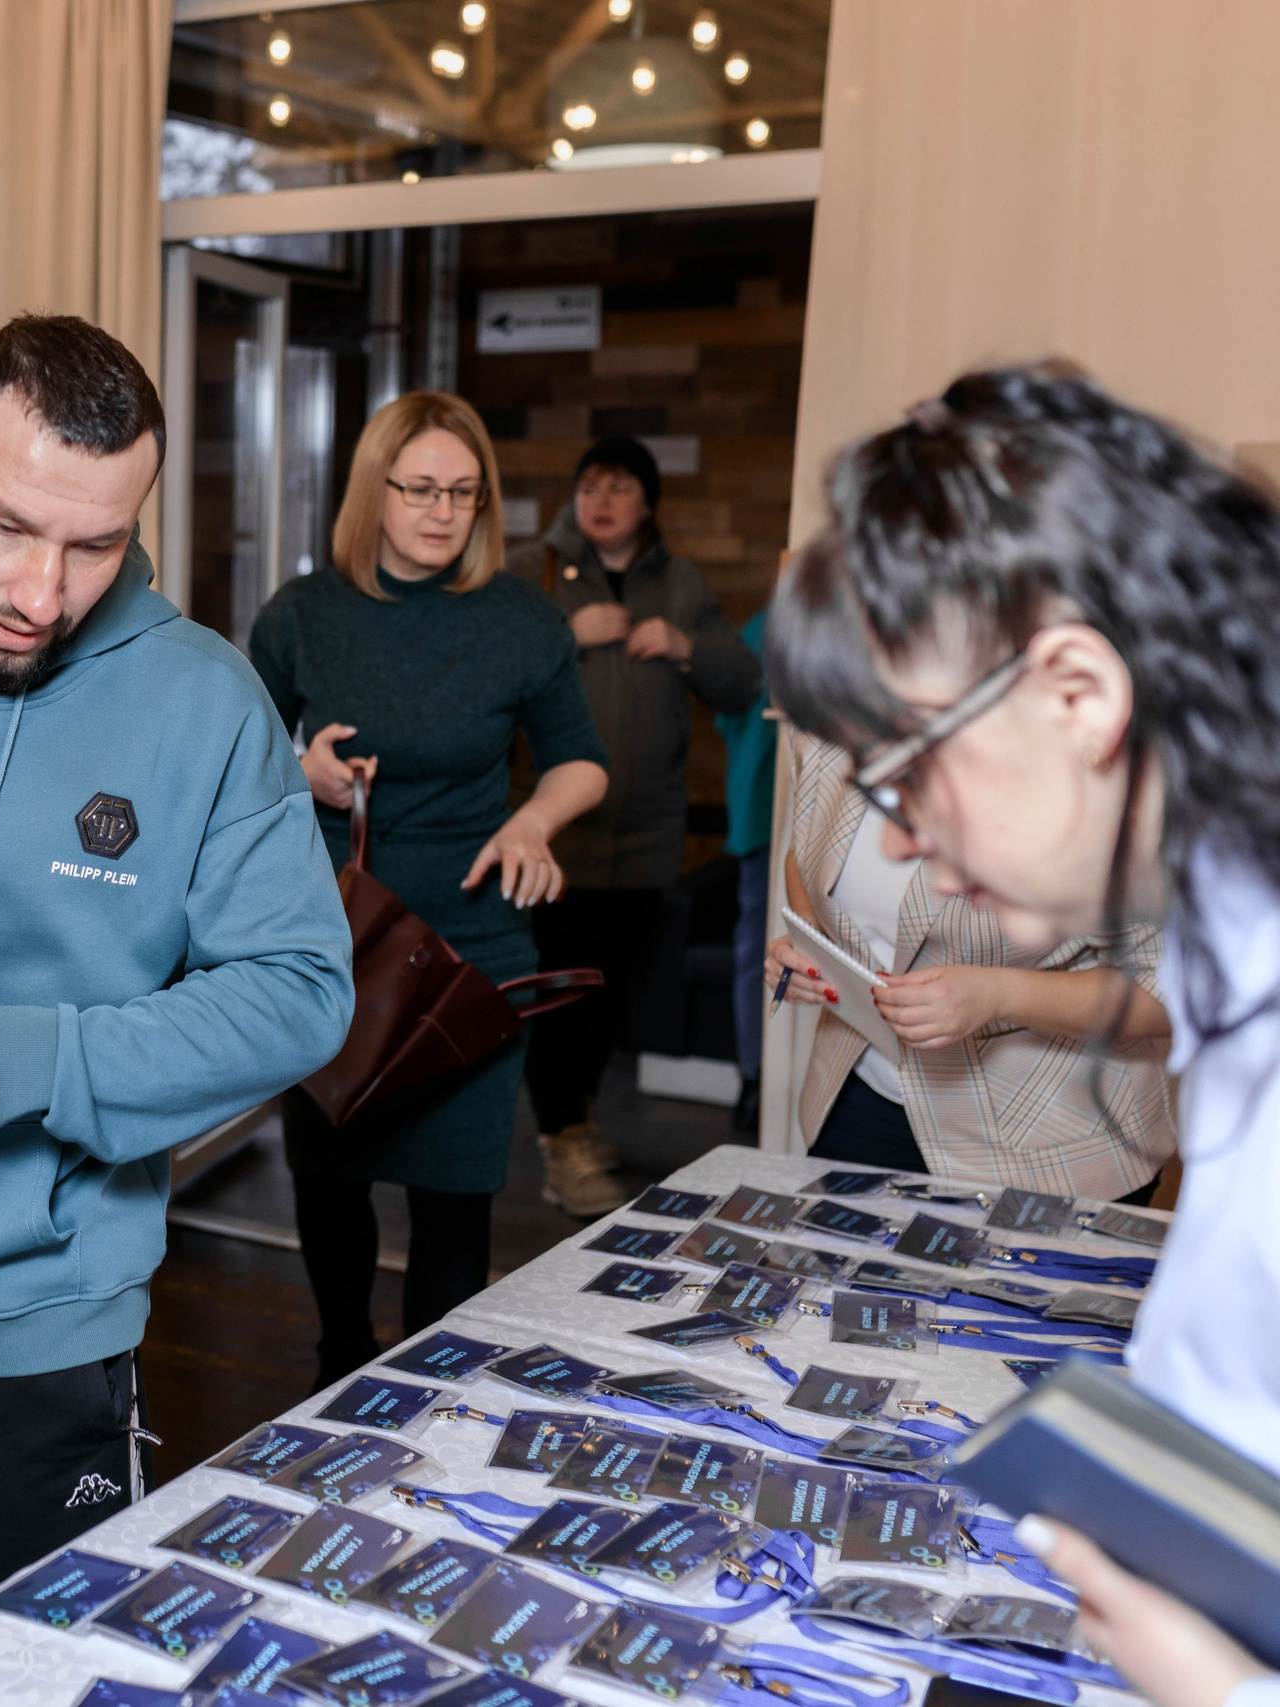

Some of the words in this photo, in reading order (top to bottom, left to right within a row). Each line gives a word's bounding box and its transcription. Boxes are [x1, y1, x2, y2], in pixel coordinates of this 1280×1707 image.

[51, 861, 101, 879] PHILIPP
[104, 871, 137, 885] PLEIN
[438, 1350, 467, 1365] СЕРГЕЙ
[544, 1367, 571, 1381] ЕЛЕНА
[377, 1396, 399, 1414] ЮЛИЯ
[265, 1440, 302, 1465] НАТАЛЬЯ
[547, 1432, 563, 1450] АННА
[313, 1448, 362, 1477] ЛАЧКОВА
[322, 1450, 381, 1485] ЕКАТЕРИНА
[589, 1443, 625, 1477] КРАСНОВА
[608, 1447, 640, 1478] ЕВГЕНИЯ
[679, 1443, 711, 1493] КРАСНОПЕРОВА
[705, 1461, 722, 1478] НИНА
[790, 1479, 808, 1522] КУДИНОВА
[810, 1483, 826, 1522] АНЕЛИНА
[201, 1511, 251, 1545] МАНАКОВА
[225, 1521, 259, 1544] МАРИЯ
[572, 1522, 600, 1547] АРТЕМ
[879, 1500, 897, 1542] КУЛАГИНА
[900, 1508, 915, 1535] ИРИНА
[300, 1522, 353, 1573] МАЙДУРОВА
[325, 1537, 363, 1571] ГАЛИНА
[659, 1528, 694, 1553] ОЛЕСЯ
[33, 1568, 85, 1600] НАУМОВА
[59, 1578, 90, 1599] АННА
[397, 1556, 458, 1595] МОРОЗОВА
[419, 1564, 468, 1597] МИЛАНА
[141, 1584, 198, 1624] НИКИТИНА
[156, 1589, 216, 1633] АНАСТАСИЯ
[491, 1599, 540, 1645] НАДЕЖДА
[617, 1623, 659, 1665] НАУМЕНКО
[643, 1636, 673, 1665] ОЛЬГА
[234, 1639, 281, 1686] НЕКРАСО
[364, 1664, 405, 1685] ЮЛИЯ
